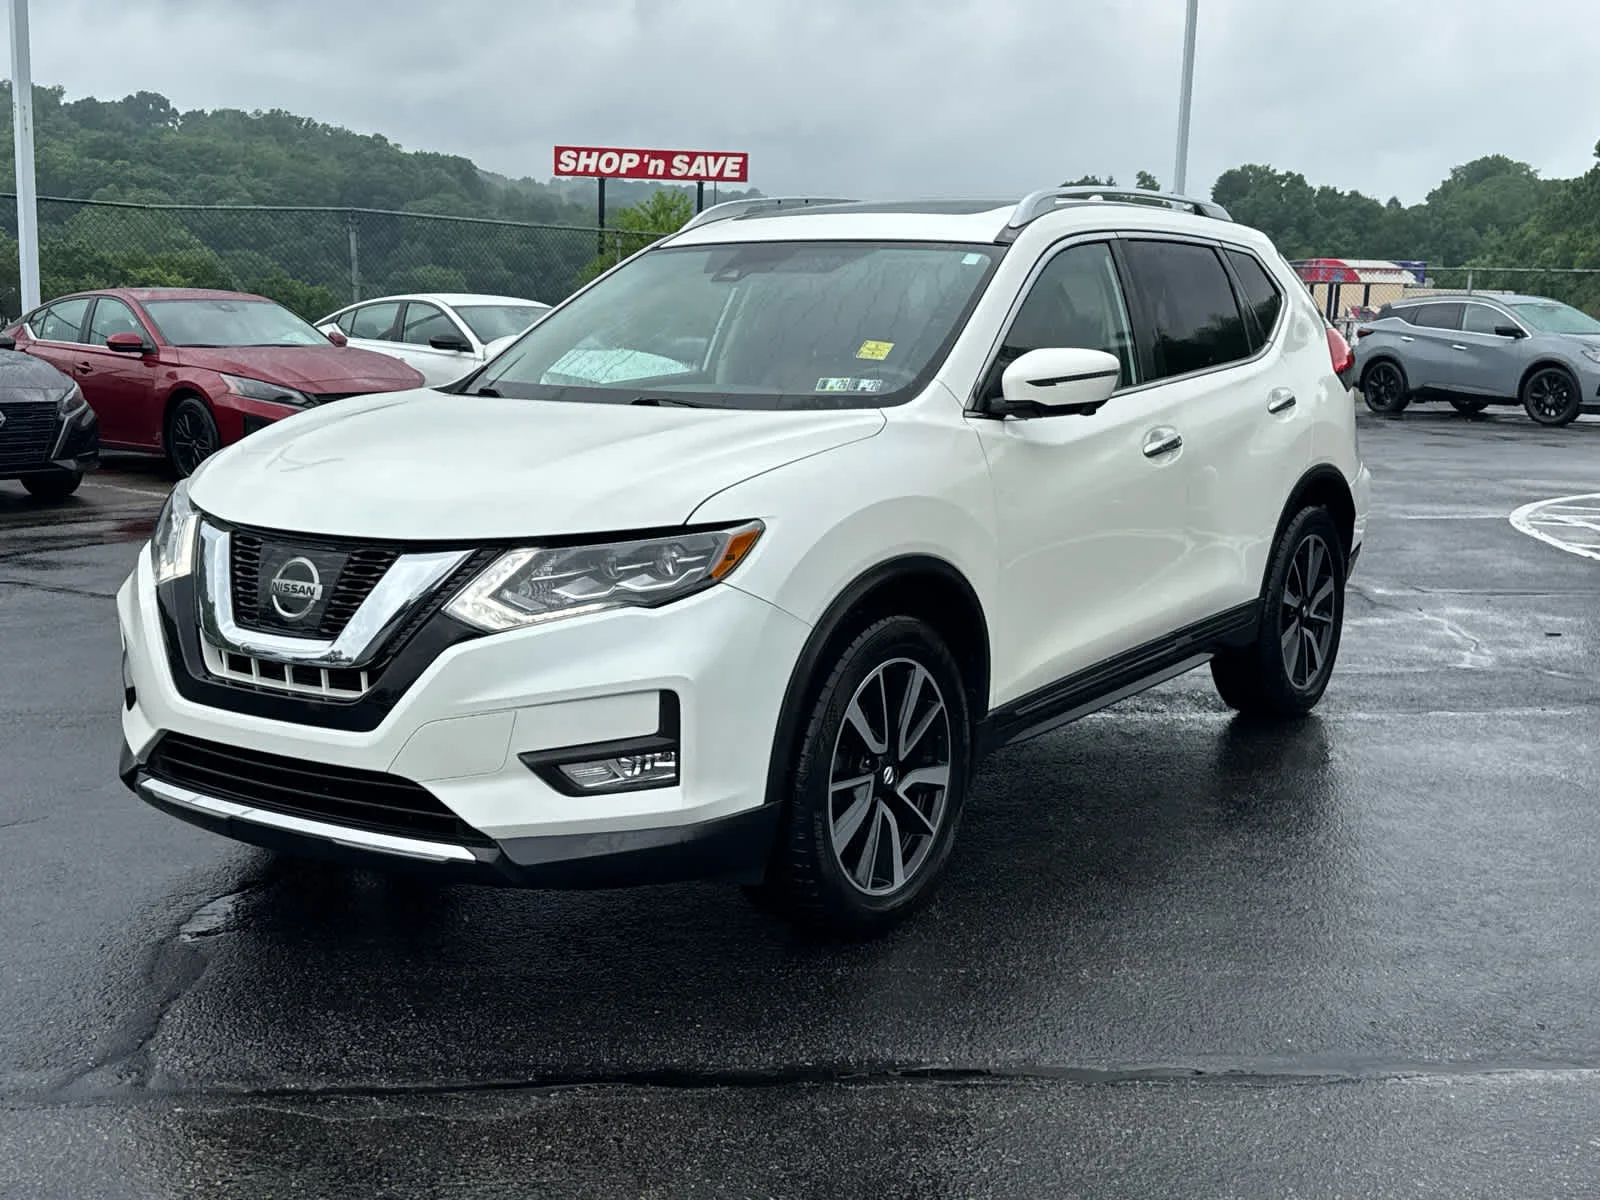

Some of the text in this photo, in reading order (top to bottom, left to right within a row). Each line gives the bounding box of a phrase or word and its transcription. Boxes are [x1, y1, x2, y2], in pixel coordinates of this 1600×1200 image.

[558, 150, 743, 178] SHOP 'n SAVE
[272, 582, 315, 595] NISSAN
